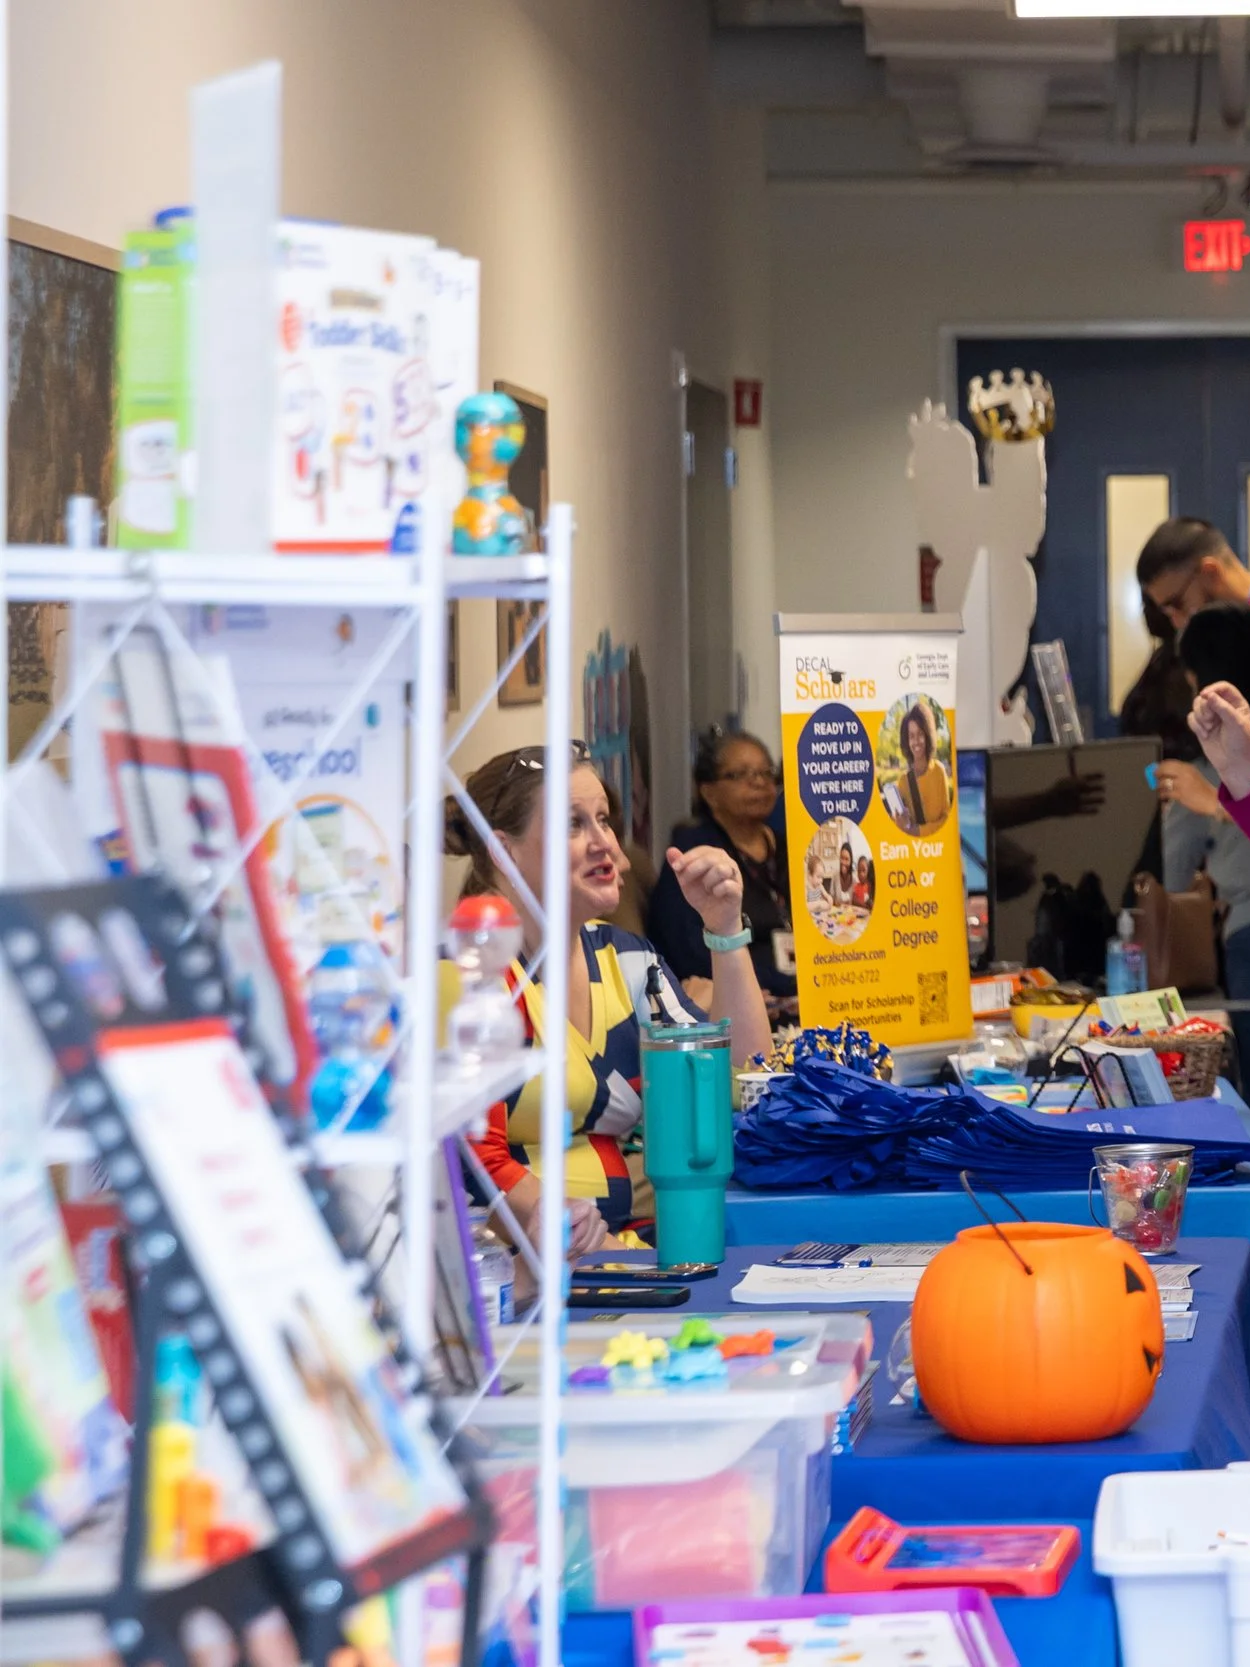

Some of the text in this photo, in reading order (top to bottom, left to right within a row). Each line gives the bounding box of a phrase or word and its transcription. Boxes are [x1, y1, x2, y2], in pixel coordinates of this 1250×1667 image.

[1184, 220, 1244, 271] EXIT
[796, 656, 833, 672] DECAL
[796, 671, 876, 699] Scholars
[814, 721, 858, 735] READY TO
[812, 741, 862, 755] MOVE UP IN
[803, 760, 870, 775] YOUR CAREER?
[811, 780, 864, 794] WE'RE HERE
[822, 800, 859, 813] TO HELP.
[880, 840, 944, 860] Earn Your
[888, 870, 935, 888] CDA or
[890, 899, 938, 919] College
[893, 930, 938, 949] Degree
[814, 950, 886, 965] decalscholars.com
[822, 969, 880, 986] 770-642-6722
[829, 995, 915, 1013] Scan for Scholarship
